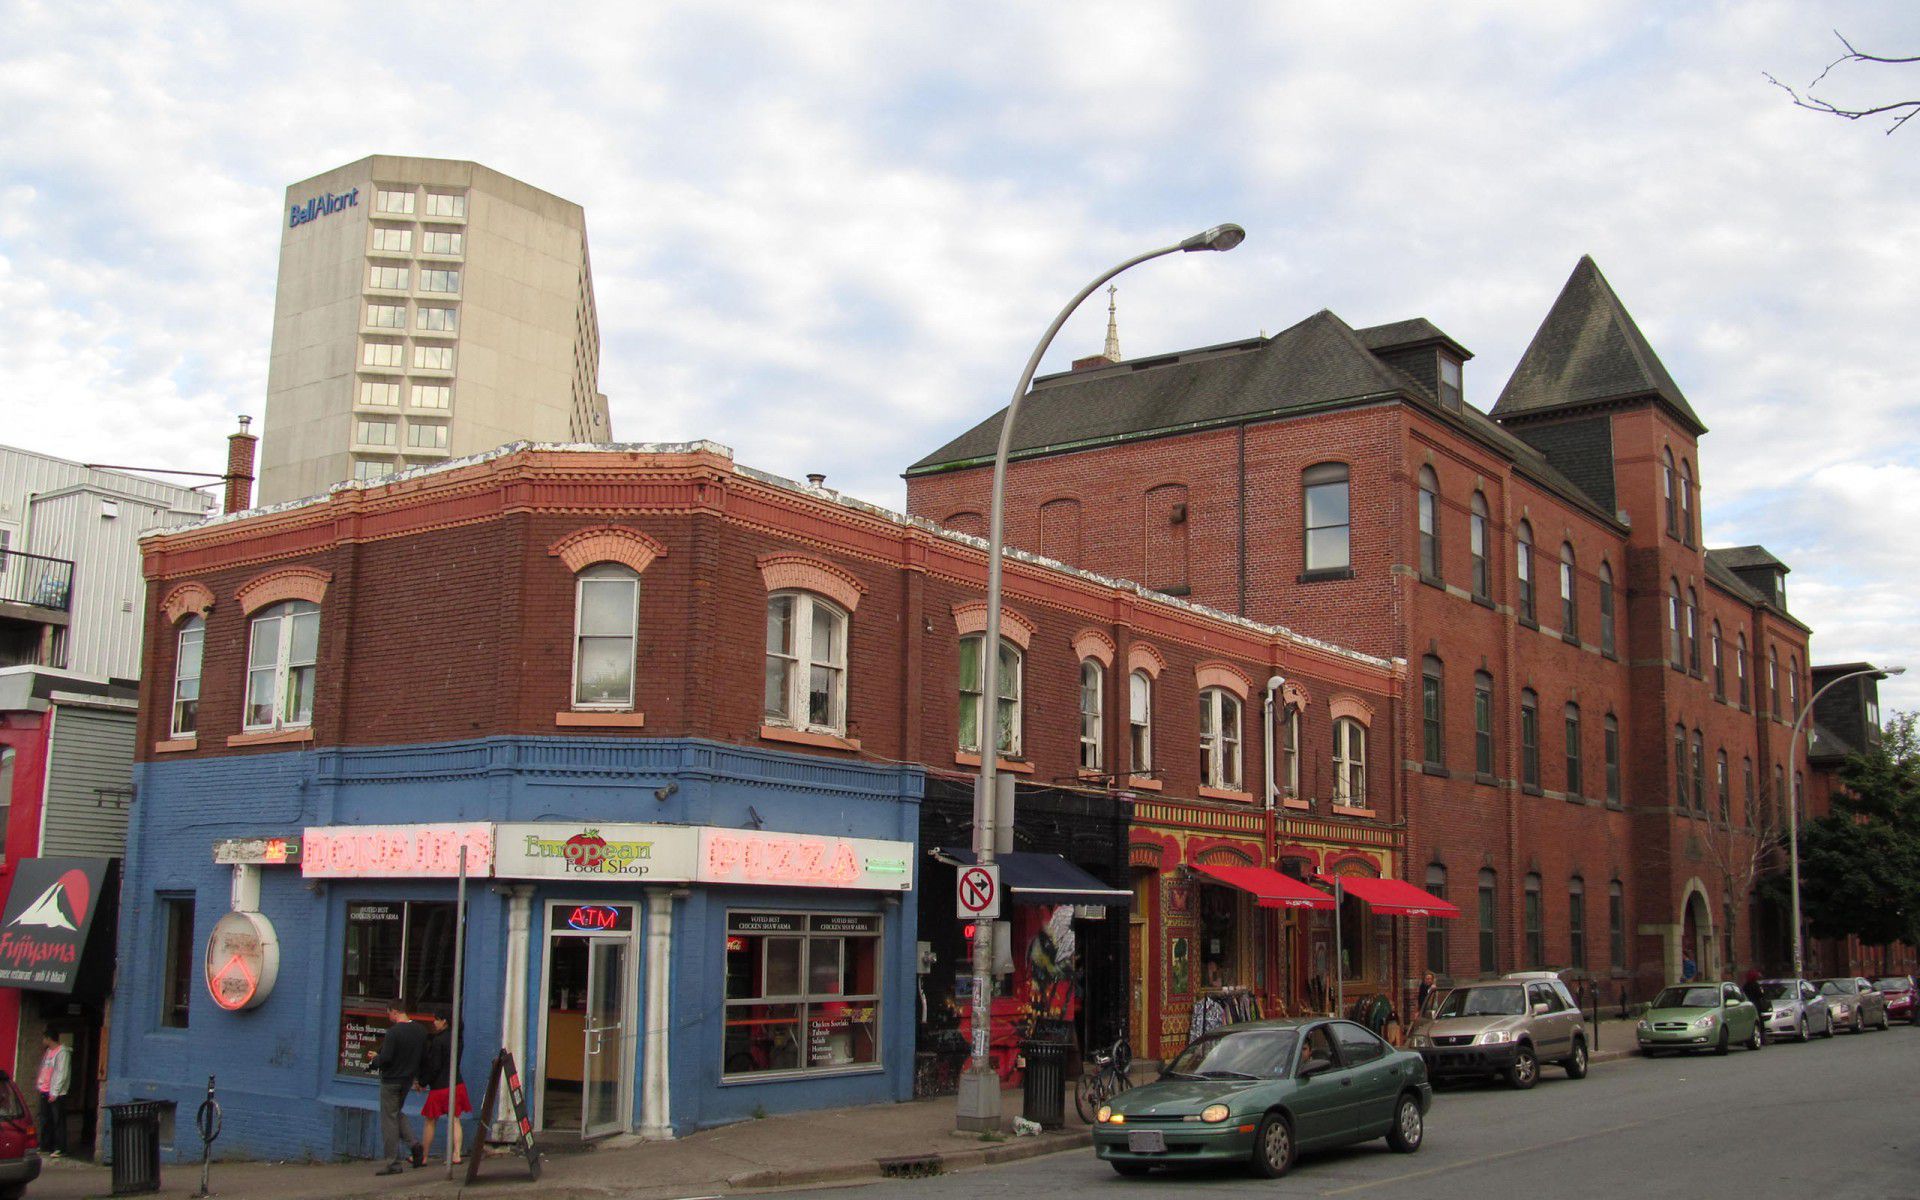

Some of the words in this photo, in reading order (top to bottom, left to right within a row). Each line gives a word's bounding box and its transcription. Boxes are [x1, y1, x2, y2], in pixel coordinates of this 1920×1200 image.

[303, 831, 490, 874] DONAIRS
[523, 834, 651, 865] European
[710, 836, 862, 883] PIZZA
[565, 858, 603, 873] Food
[607, 860, 649, 876] Shop
[570, 907, 617, 928] ATM
[0, 932, 76, 968] Fujiyama
